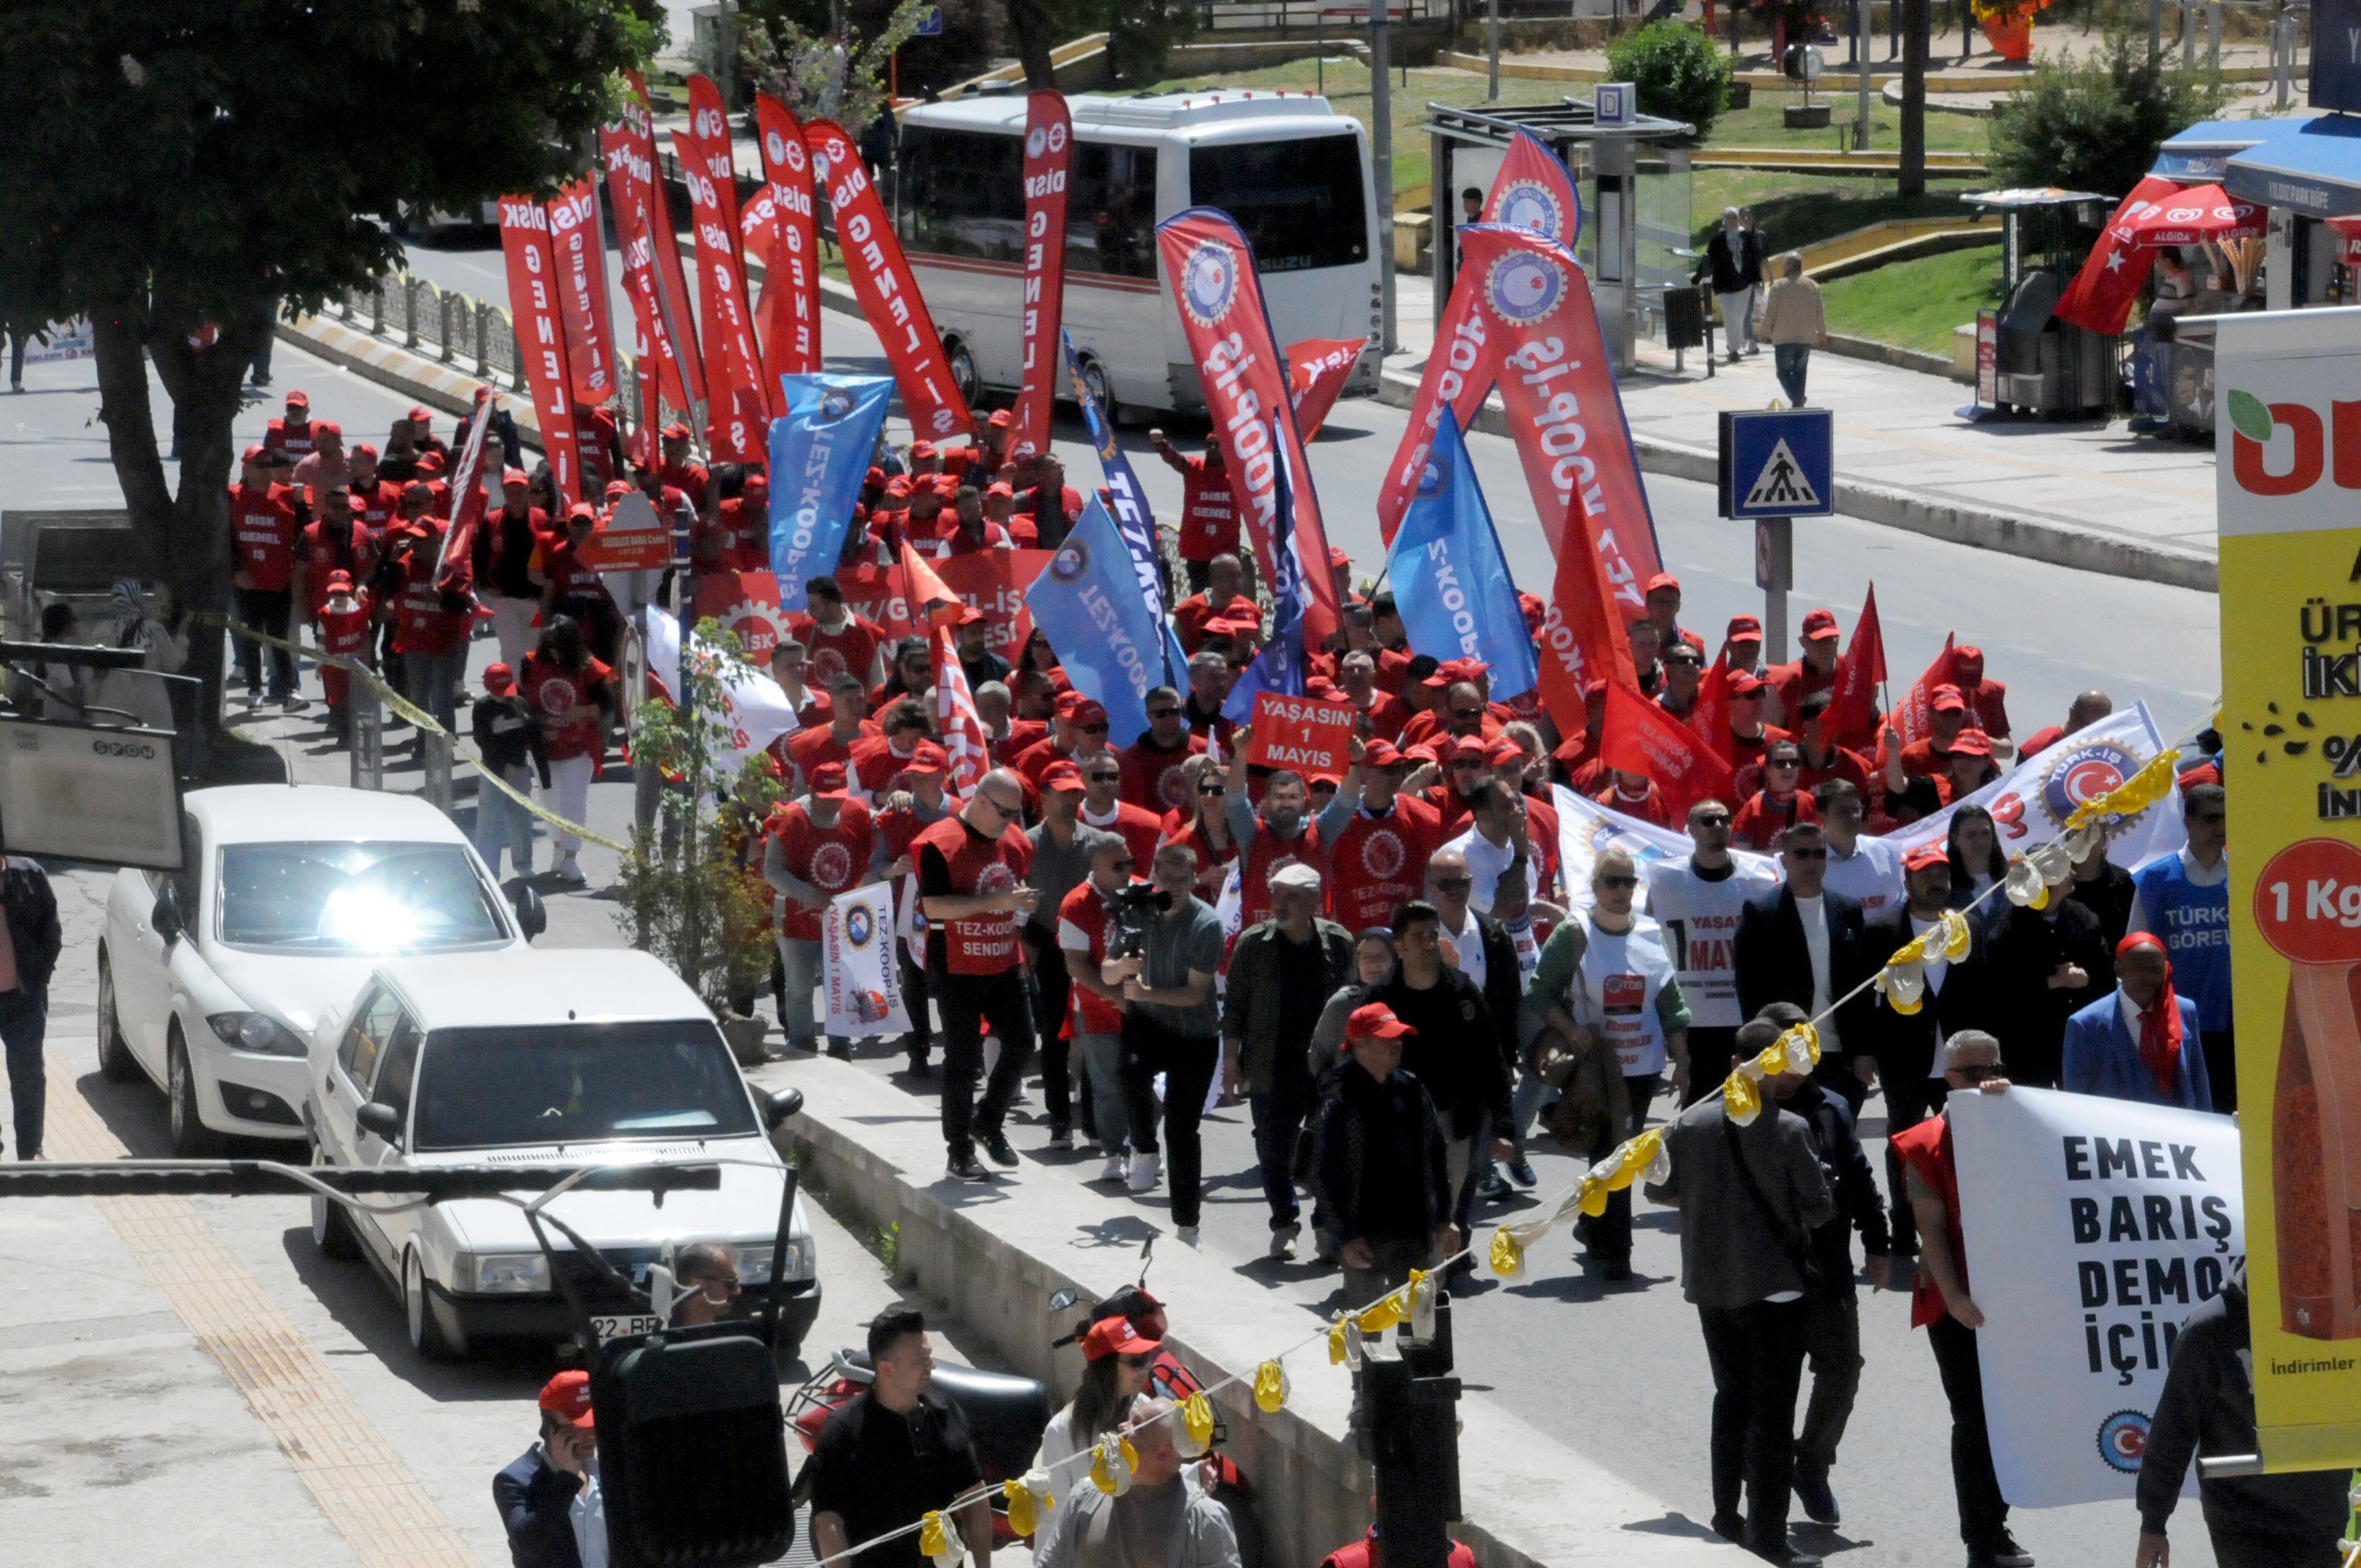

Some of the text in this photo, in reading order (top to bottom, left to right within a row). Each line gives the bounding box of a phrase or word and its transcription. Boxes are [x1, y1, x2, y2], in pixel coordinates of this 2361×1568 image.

[1261, 699, 1352, 727] YAŞASIN
[1301, 727, 1310, 743] 1
[1266, 744, 1332, 768] MAYIS
[2049, 747, 2122, 783] TÜRK-İŞ
[2270, 878, 2361, 928] 1 Kg
[2062, 1135, 2207, 1182] EMEK
[2070, 1194, 2232, 1254] BARIŞ
[2077, 1255, 2239, 1308] DEMO
[2271, 1357, 2356, 1375] İndirimler
